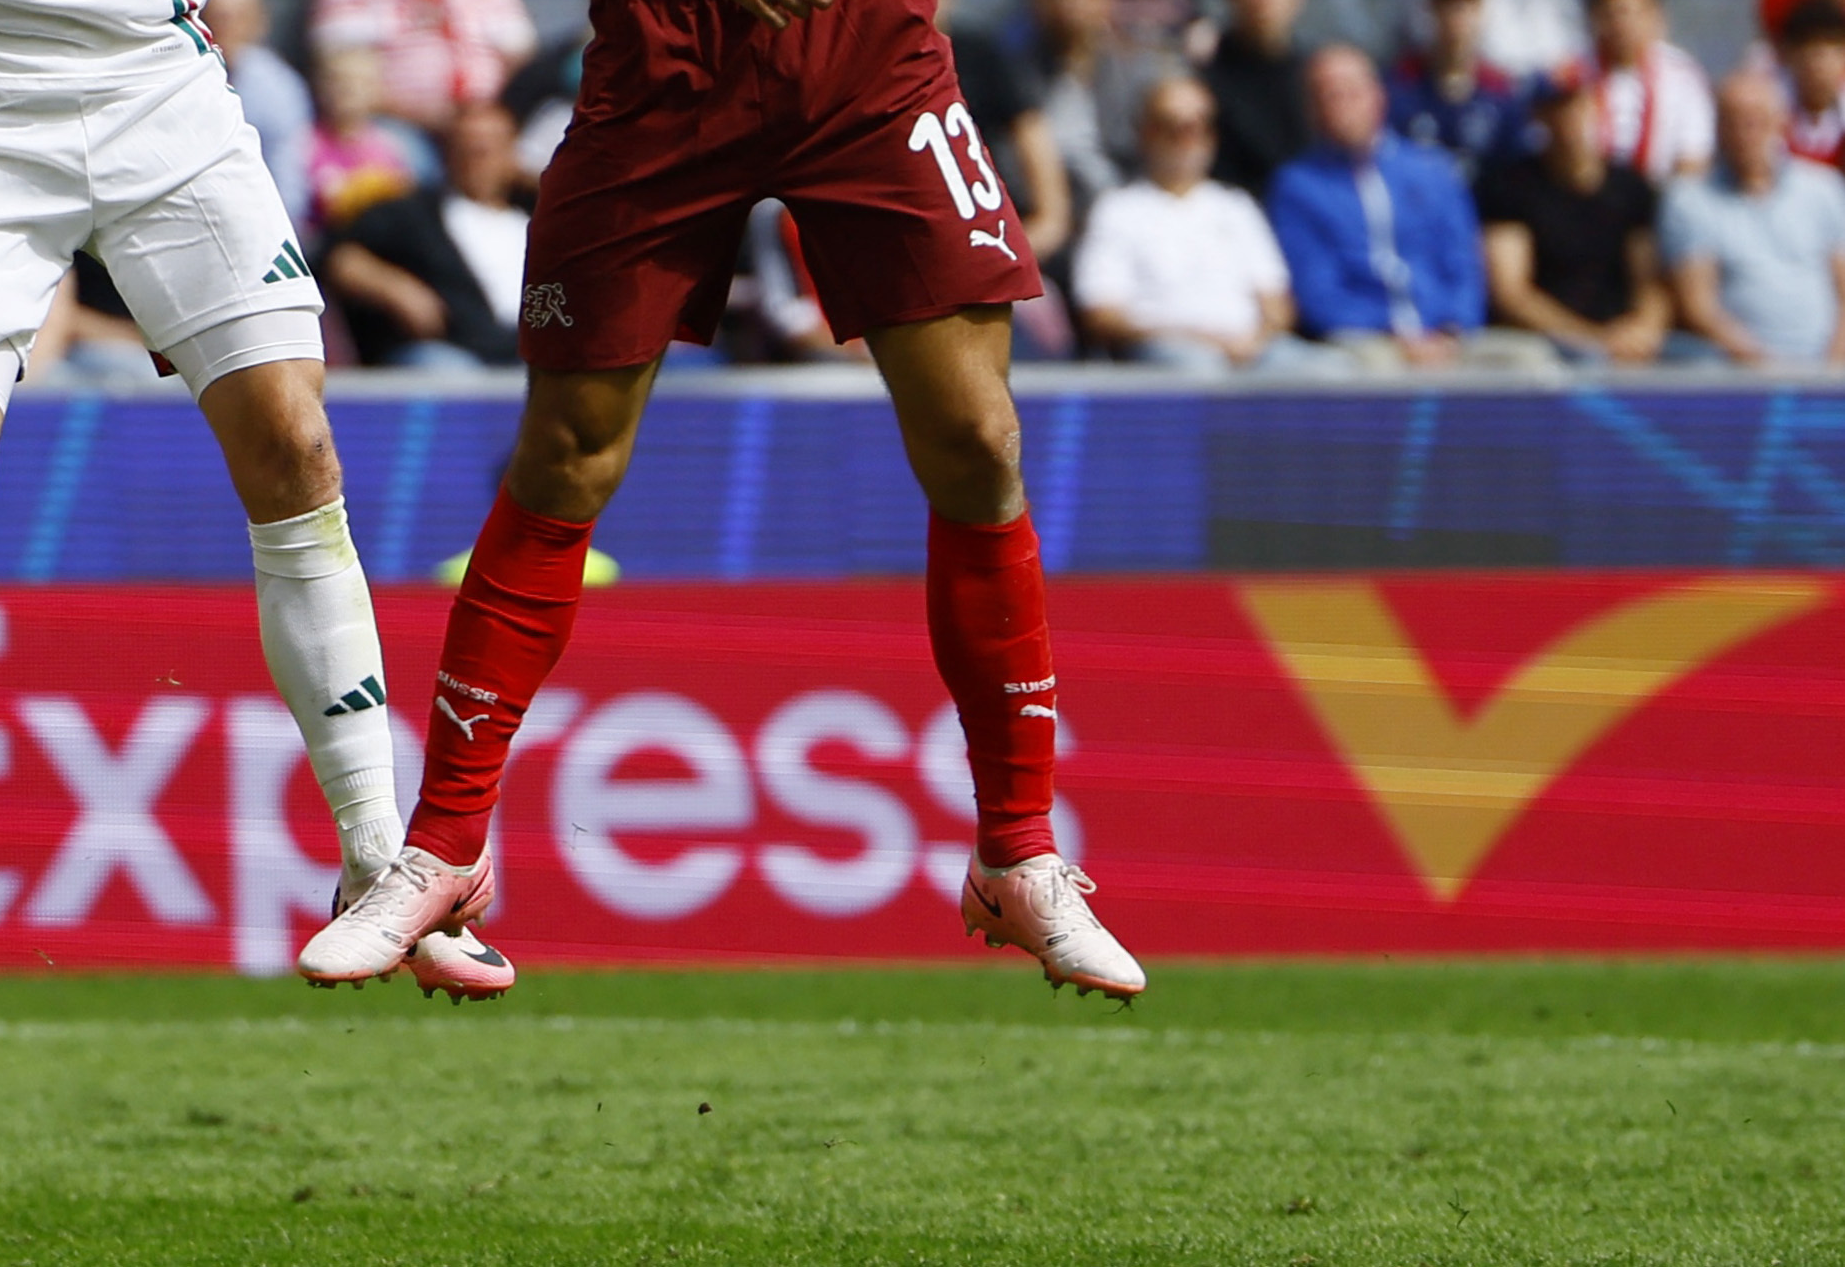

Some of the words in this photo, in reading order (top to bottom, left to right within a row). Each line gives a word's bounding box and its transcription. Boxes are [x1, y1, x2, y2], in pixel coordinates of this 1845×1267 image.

[908, 102, 1002, 220] 13
[438, 670, 499, 705] SUISSE
[1004, 673, 1056, 693] SUISS
